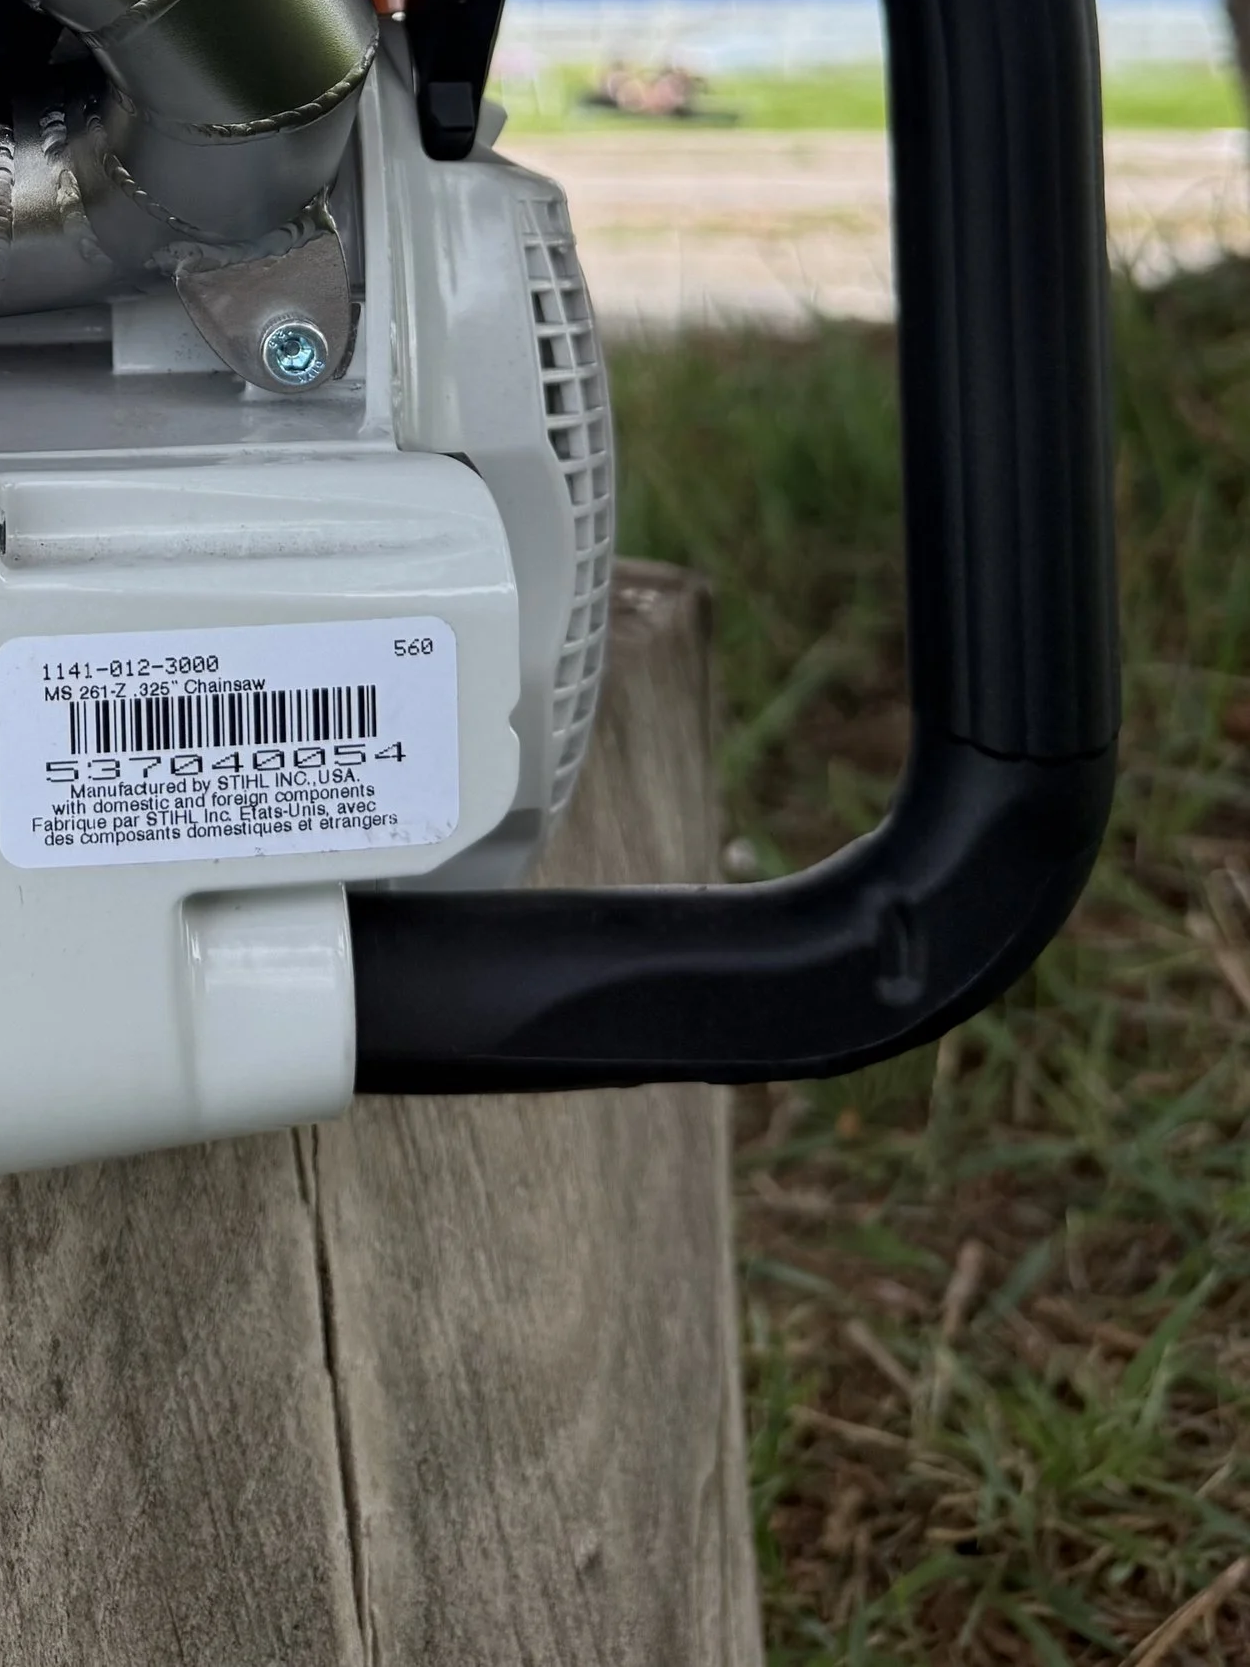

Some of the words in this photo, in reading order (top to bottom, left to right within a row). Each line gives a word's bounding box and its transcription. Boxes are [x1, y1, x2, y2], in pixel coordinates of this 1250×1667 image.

[393, 637, 434, 657] 560
[42, 655, 220, 681] 1141-012-3000
[44, 685, 73, 702] MS
[79, 682, 127, 700] 261-Z
[133, 679, 179, 699] .325"
[184, 677, 266, 695] Chainsaw
[45, 741, 407, 783] 537040054
[51, 800, 87, 816] with
[93, 795, 170, 815] domestic
[173, 793, 206, 809] and
[211, 789, 269, 808] foreign
[274, 784, 376, 805] components
[70, 778, 187, 800] Manufactured
[192, 777, 212, 795] by
[217, 774, 270, 792] STIHL
[32, 815, 108, 834] Fabrique
[113, 814, 141, 832] par
[146, 809, 199, 827] STIHL
[204, 808, 232, 825] Inc.
[336, 800, 377, 815] avec
[44, 832, 75, 847] des
[80, 826, 182, 847] composants
[187, 819, 293, 839] domestiques
[298, 819, 313, 832] et
[319, 812, 399, 831] etrangers
